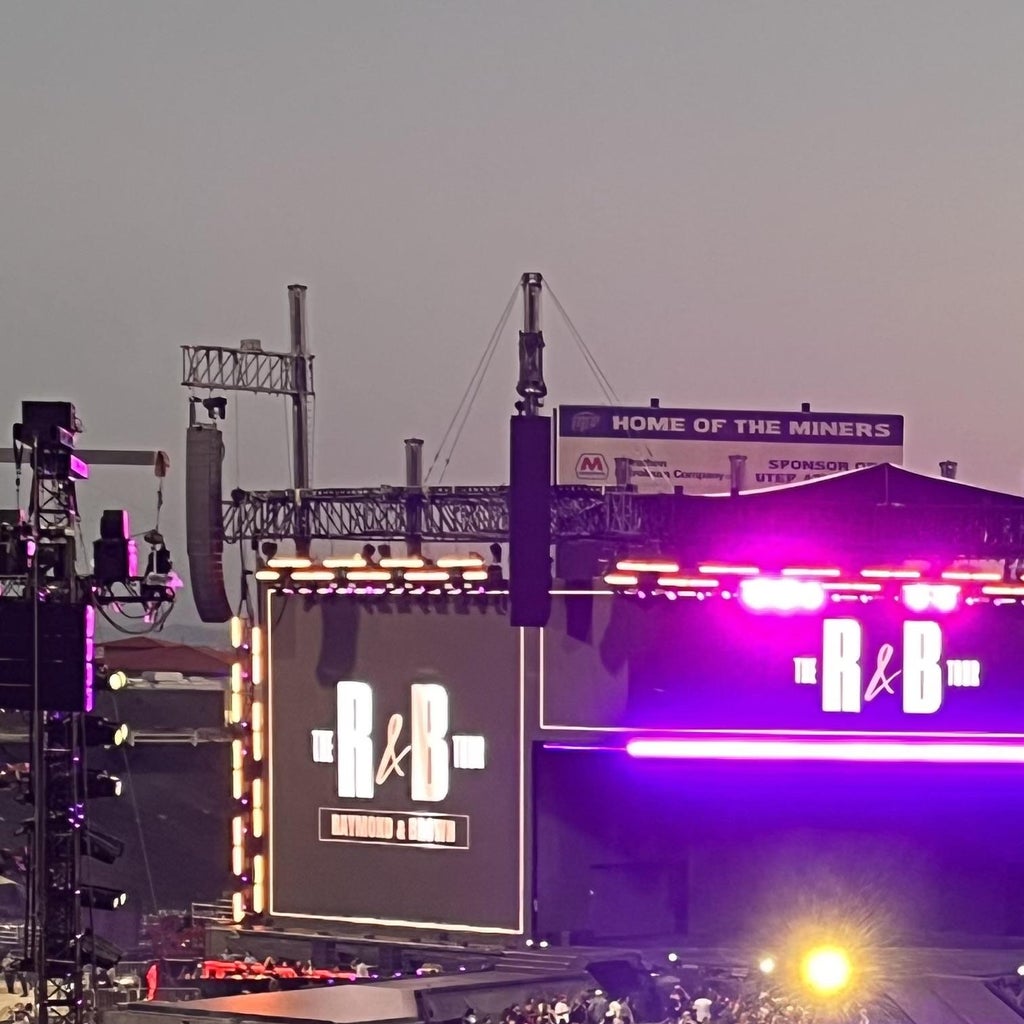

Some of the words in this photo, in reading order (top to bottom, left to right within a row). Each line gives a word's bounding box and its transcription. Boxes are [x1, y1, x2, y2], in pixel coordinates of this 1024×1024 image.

[612, 416, 686, 432] HOME
[693, 418, 726, 432] OF
[734, 420, 781, 434] THE
[789, 420, 891, 438] MINERS
[768, 460, 849, 471] SPONSOR
[674, 470, 724, 480] Company
[756, 473, 796, 483] UTEP
[822, 618, 942, 714] R&B
[336, 680, 448, 802] R&B
